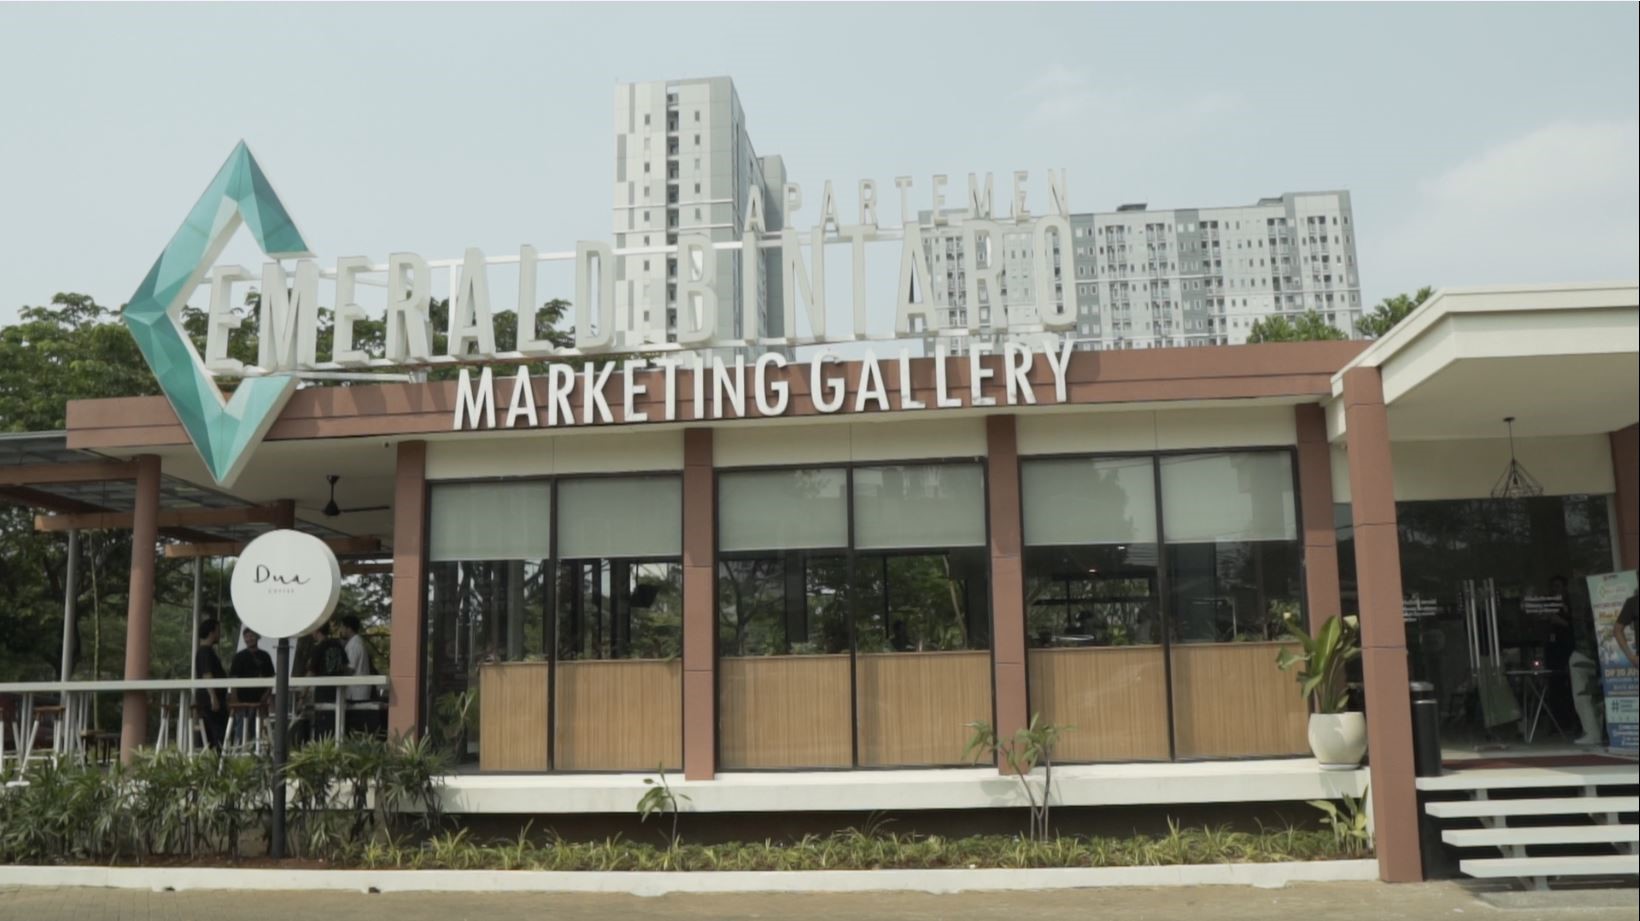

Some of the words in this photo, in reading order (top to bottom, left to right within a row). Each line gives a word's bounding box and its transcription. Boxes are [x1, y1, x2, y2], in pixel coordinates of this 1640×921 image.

[744, 168, 1071, 233] APARTEMEN
[205, 240, 616, 375] EMERALD
[677, 214, 1078, 347] BINTARO
[453, 352, 789, 431] MARKETING
[810, 338, 1074, 413] GALLERY
